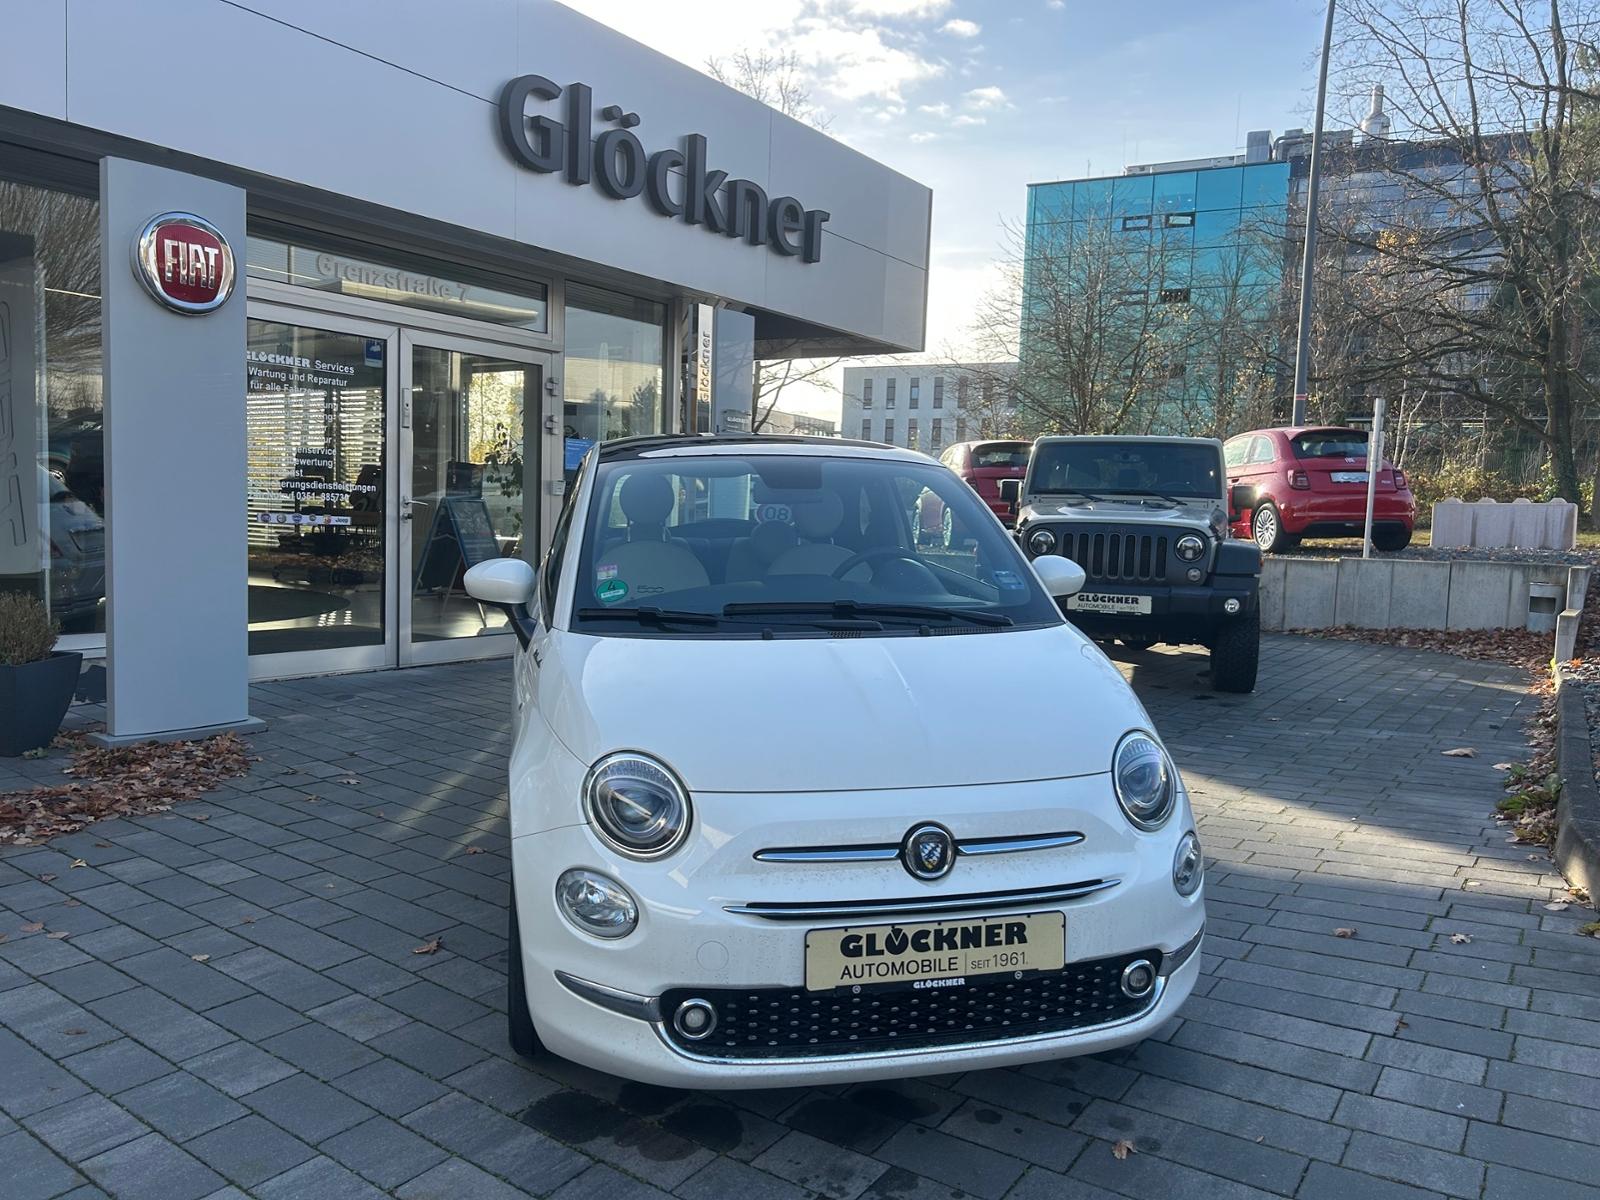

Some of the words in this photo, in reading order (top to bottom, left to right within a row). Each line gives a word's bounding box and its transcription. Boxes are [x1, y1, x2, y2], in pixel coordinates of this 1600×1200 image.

[500, 74, 831, 264] Glöckner
[163, 238, 219, 290] FIAT
[315, 253, 451, 298] Grenzstraße
[456, 283, 472, 304] 7
[248, 366, 287, 381] Wartung
[289, 373, 305, 382] und
[307, 374, 348, 386] Reparatur
[315, 360, 355, 374] Services
[250, 380, 263, 389] für
[265, 382, 280, 392] alle
[1077, 594, 1140, 605] GLÖCKNER
[839, 921, 1028, 958] GLÖCKNER
[839, 956, 959, 980] AUTOMOBILE
[970, 959, 991, 970] SEIT
[912, 977, 966, 989] GLÖCKNER
